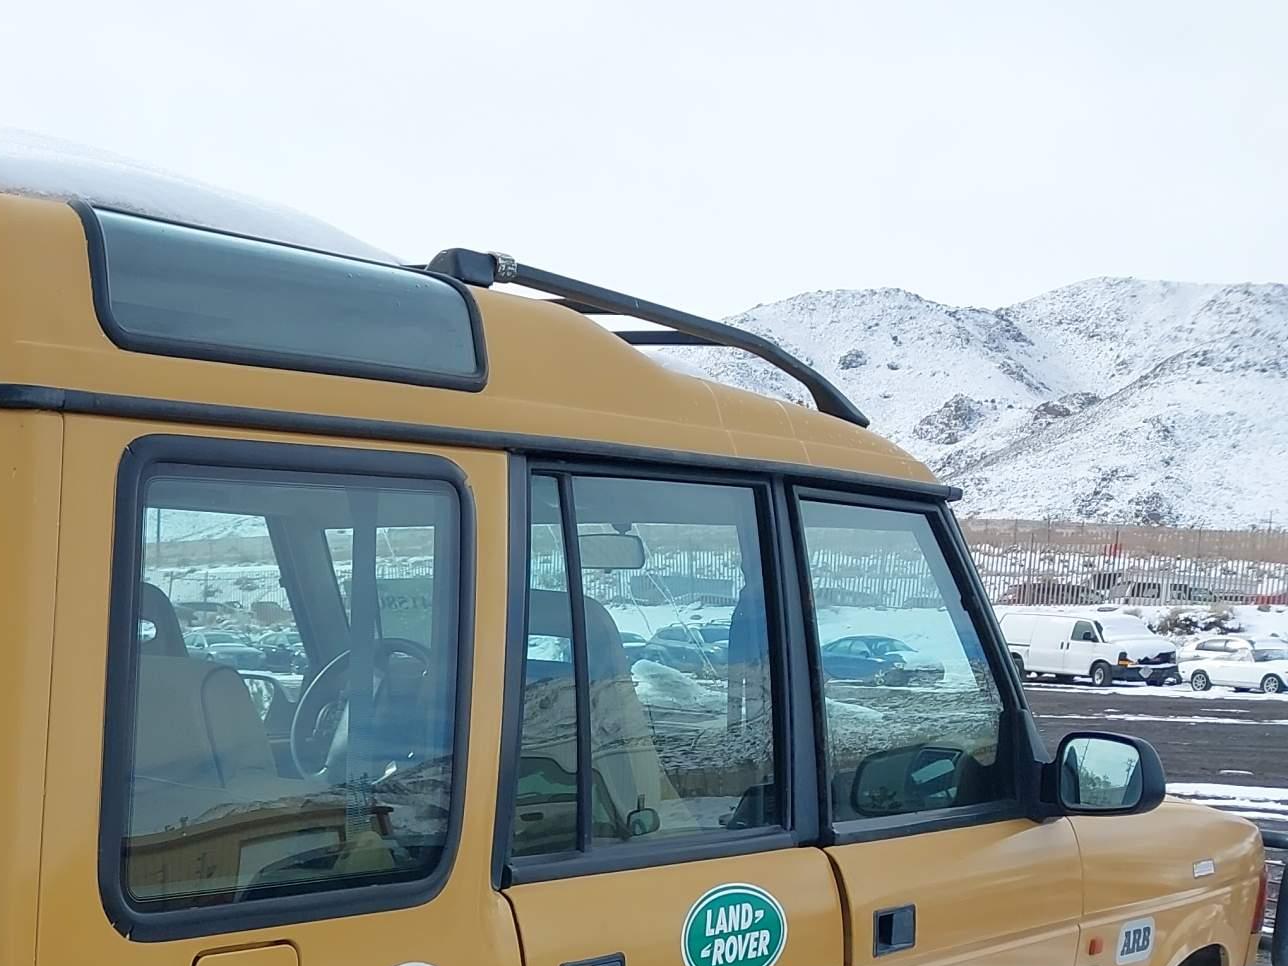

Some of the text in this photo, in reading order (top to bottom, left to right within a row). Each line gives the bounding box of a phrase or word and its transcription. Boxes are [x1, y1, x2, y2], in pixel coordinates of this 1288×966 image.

[705, 903, 753, 937] LAND
[711, 929, 770, 966] ROVER
[1120, 926, 1151, 956] ARB
